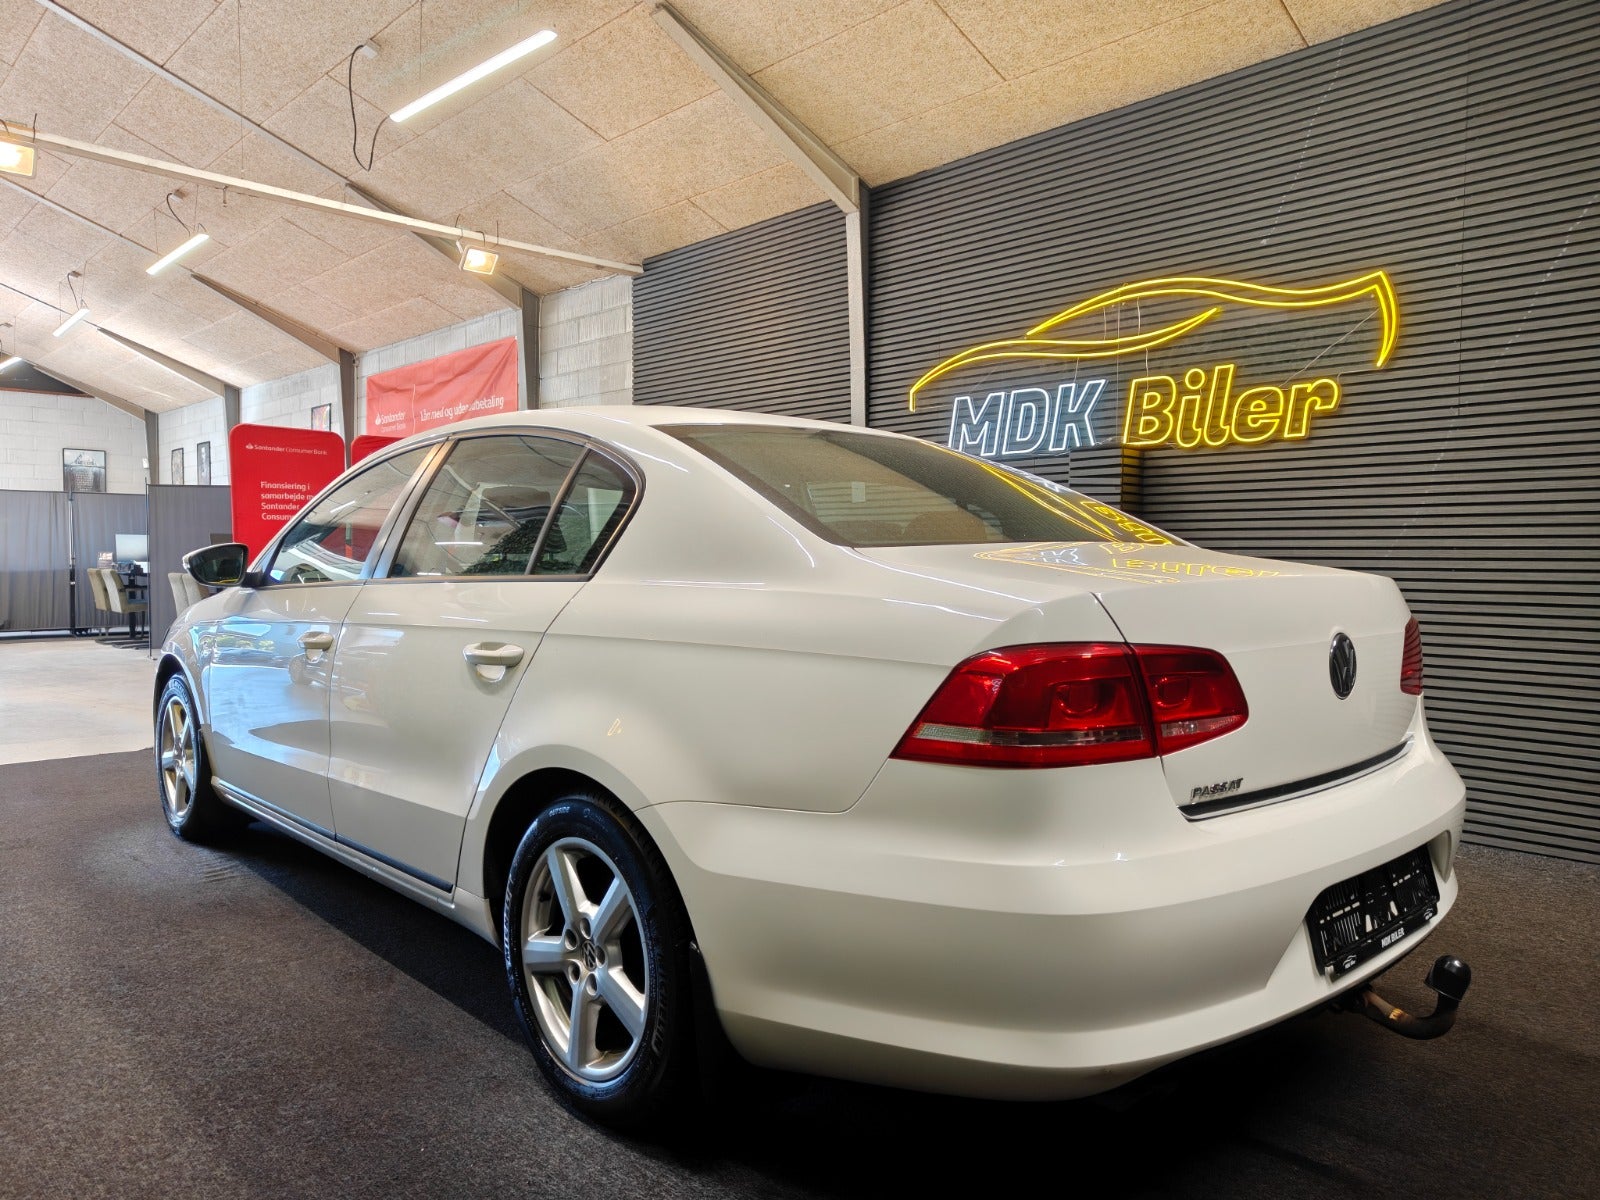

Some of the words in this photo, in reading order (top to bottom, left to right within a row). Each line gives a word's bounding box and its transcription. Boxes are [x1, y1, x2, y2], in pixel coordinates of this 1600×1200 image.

[948, 379, 1107, 457] MDK
[1121, 363, 1341, 448] Biler
[260, 481, 306, 491] Finansiering
[260, 492, 305, 501] samarbejde
[261, 502, 300, 510] Santander
[261, 512, 293, 521] Consum
[1191, 777, 1244, 799] PASSAT
[1390, 927, 1405, 942] BILER
